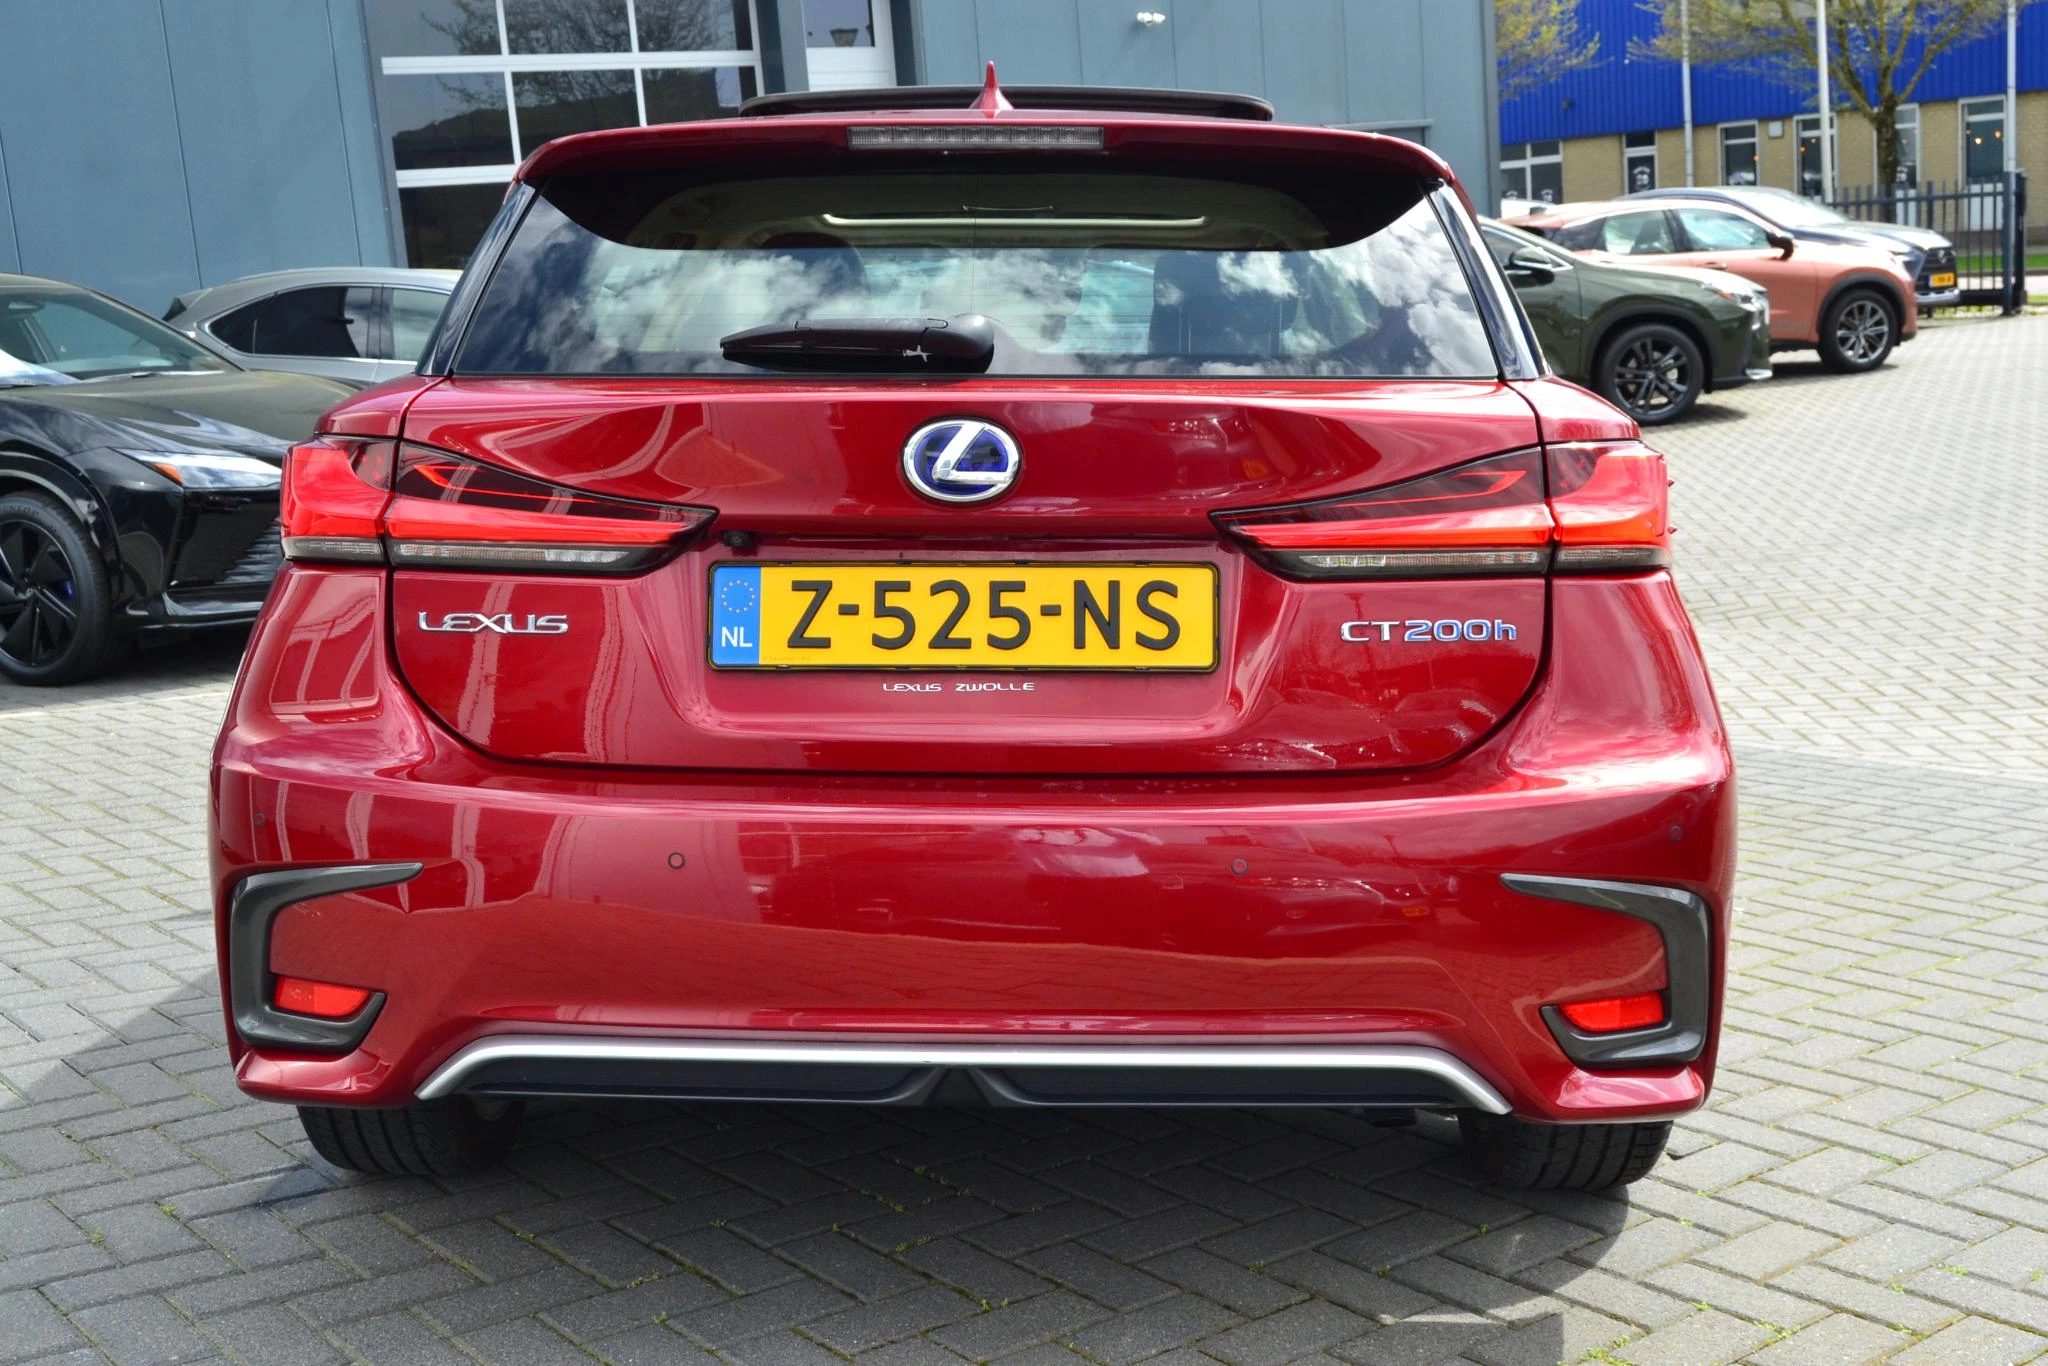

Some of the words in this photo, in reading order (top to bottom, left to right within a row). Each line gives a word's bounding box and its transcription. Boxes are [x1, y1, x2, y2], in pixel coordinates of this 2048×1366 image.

[0, 503, 40, 517] UNLOP
[418, 611, 569, 634] LEXUS
[787, 579, 1181, 651] Z-525-NS
[721, 626, 753, 648] NL
[882, 683, 942, 692] LEXUS
[955, 682, 1036, 692] ZWOLLE
